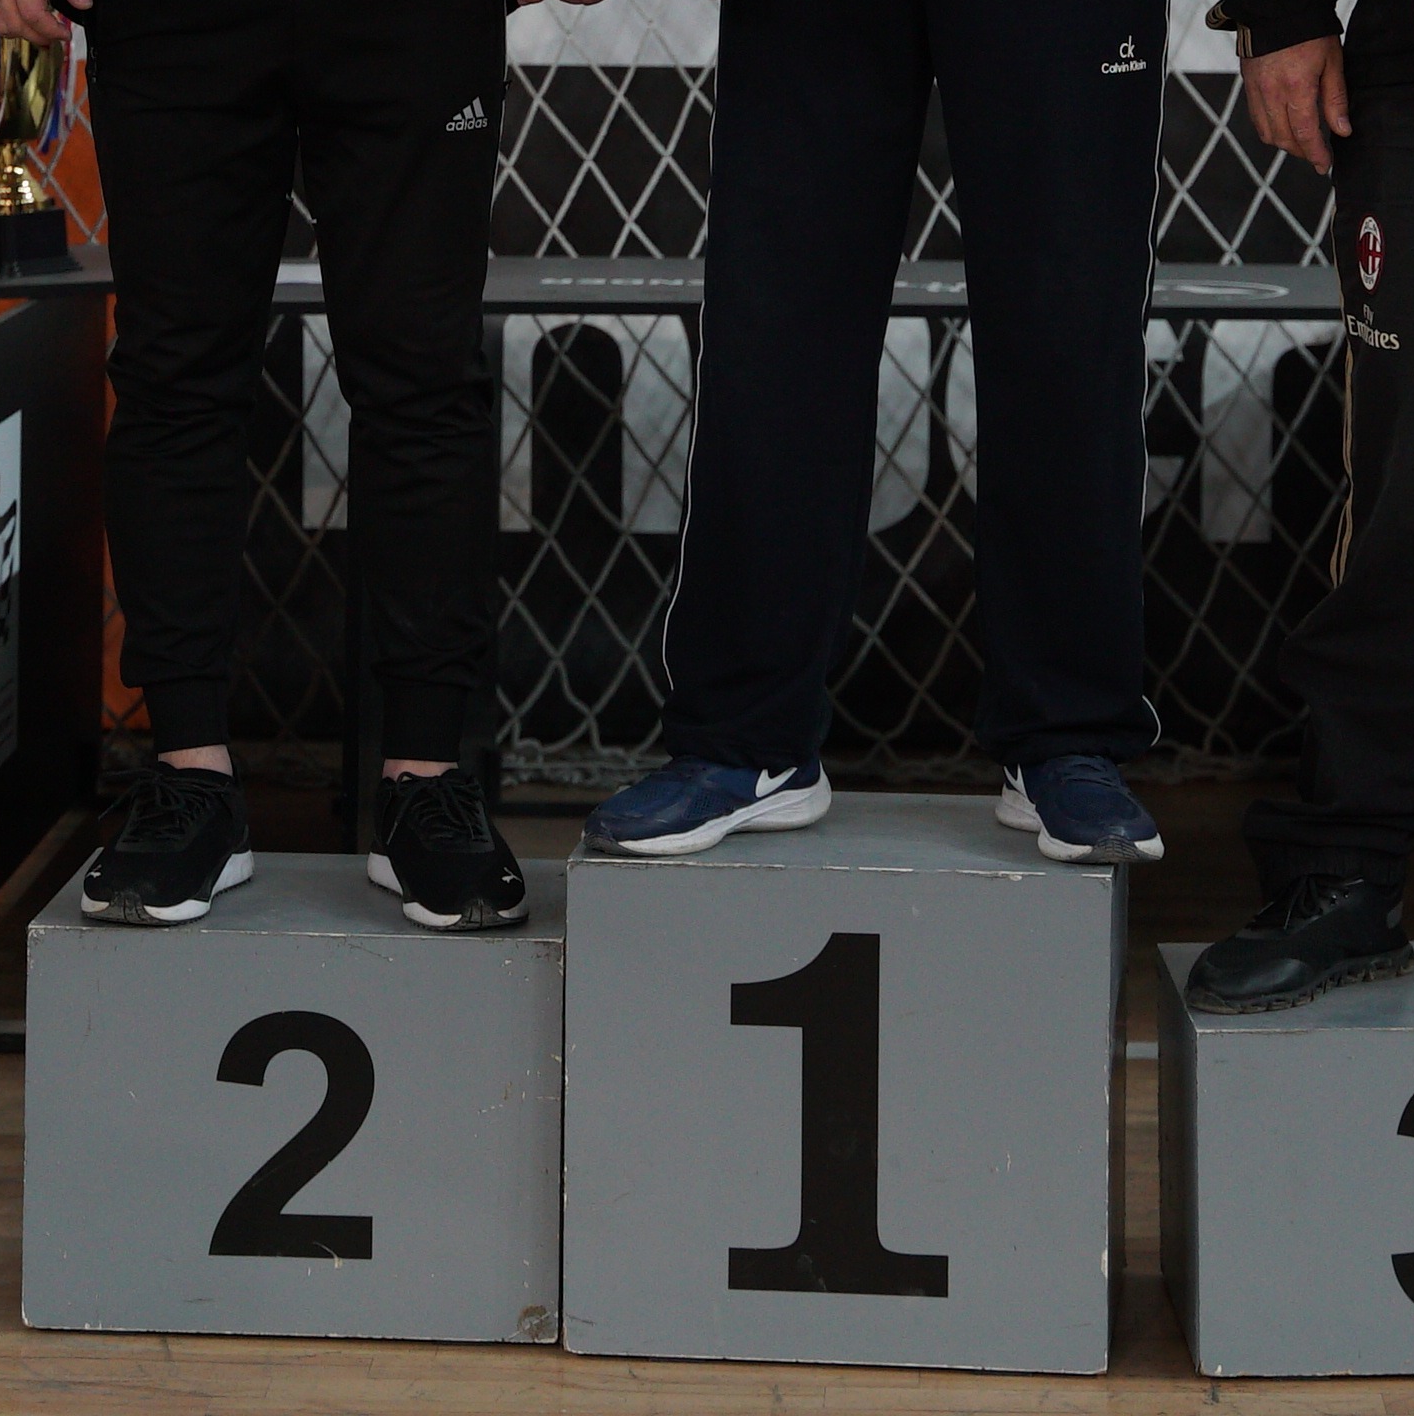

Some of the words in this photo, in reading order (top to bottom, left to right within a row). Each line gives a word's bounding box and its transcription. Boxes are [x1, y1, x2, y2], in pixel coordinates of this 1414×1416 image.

[1101, 62, 1129, 74] Calvin
[1130, 59, 1147, 71] Klein
[446, 118, 488, 131] adidas
[1347, 314, 1400, 350] Emirates
[728, 932, 949, 1299] 1
[208, 1010, 376, 1260] 2
